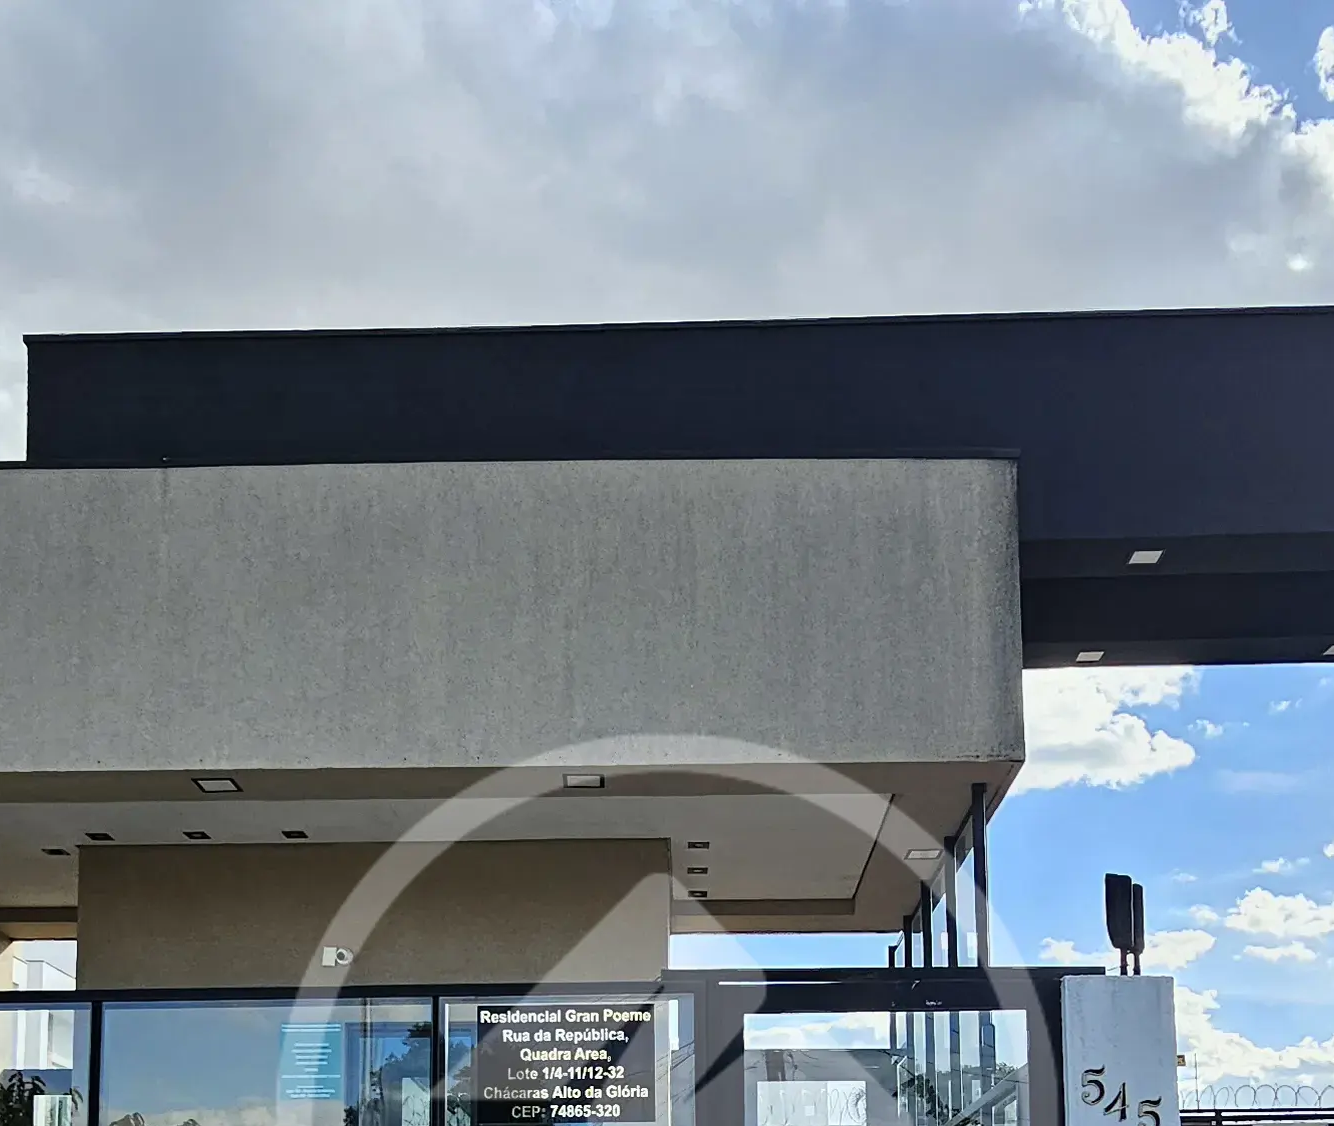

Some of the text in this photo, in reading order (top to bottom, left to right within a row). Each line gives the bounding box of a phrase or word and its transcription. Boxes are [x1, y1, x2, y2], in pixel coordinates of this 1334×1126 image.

[480, 1009, 651, 1024] Residencial Gran Poeme
[502, 1027, 629, 1044] Rua da República,
[520, 1048, 571, 1062] Quadra
[507, 1066, 625, 1080] Lote 1/4-11/12-32
[483, 1085, 649, 1099] Chácaras Alto da Glória
[511, 1104, 621, 1118] CEP: 74865-320
